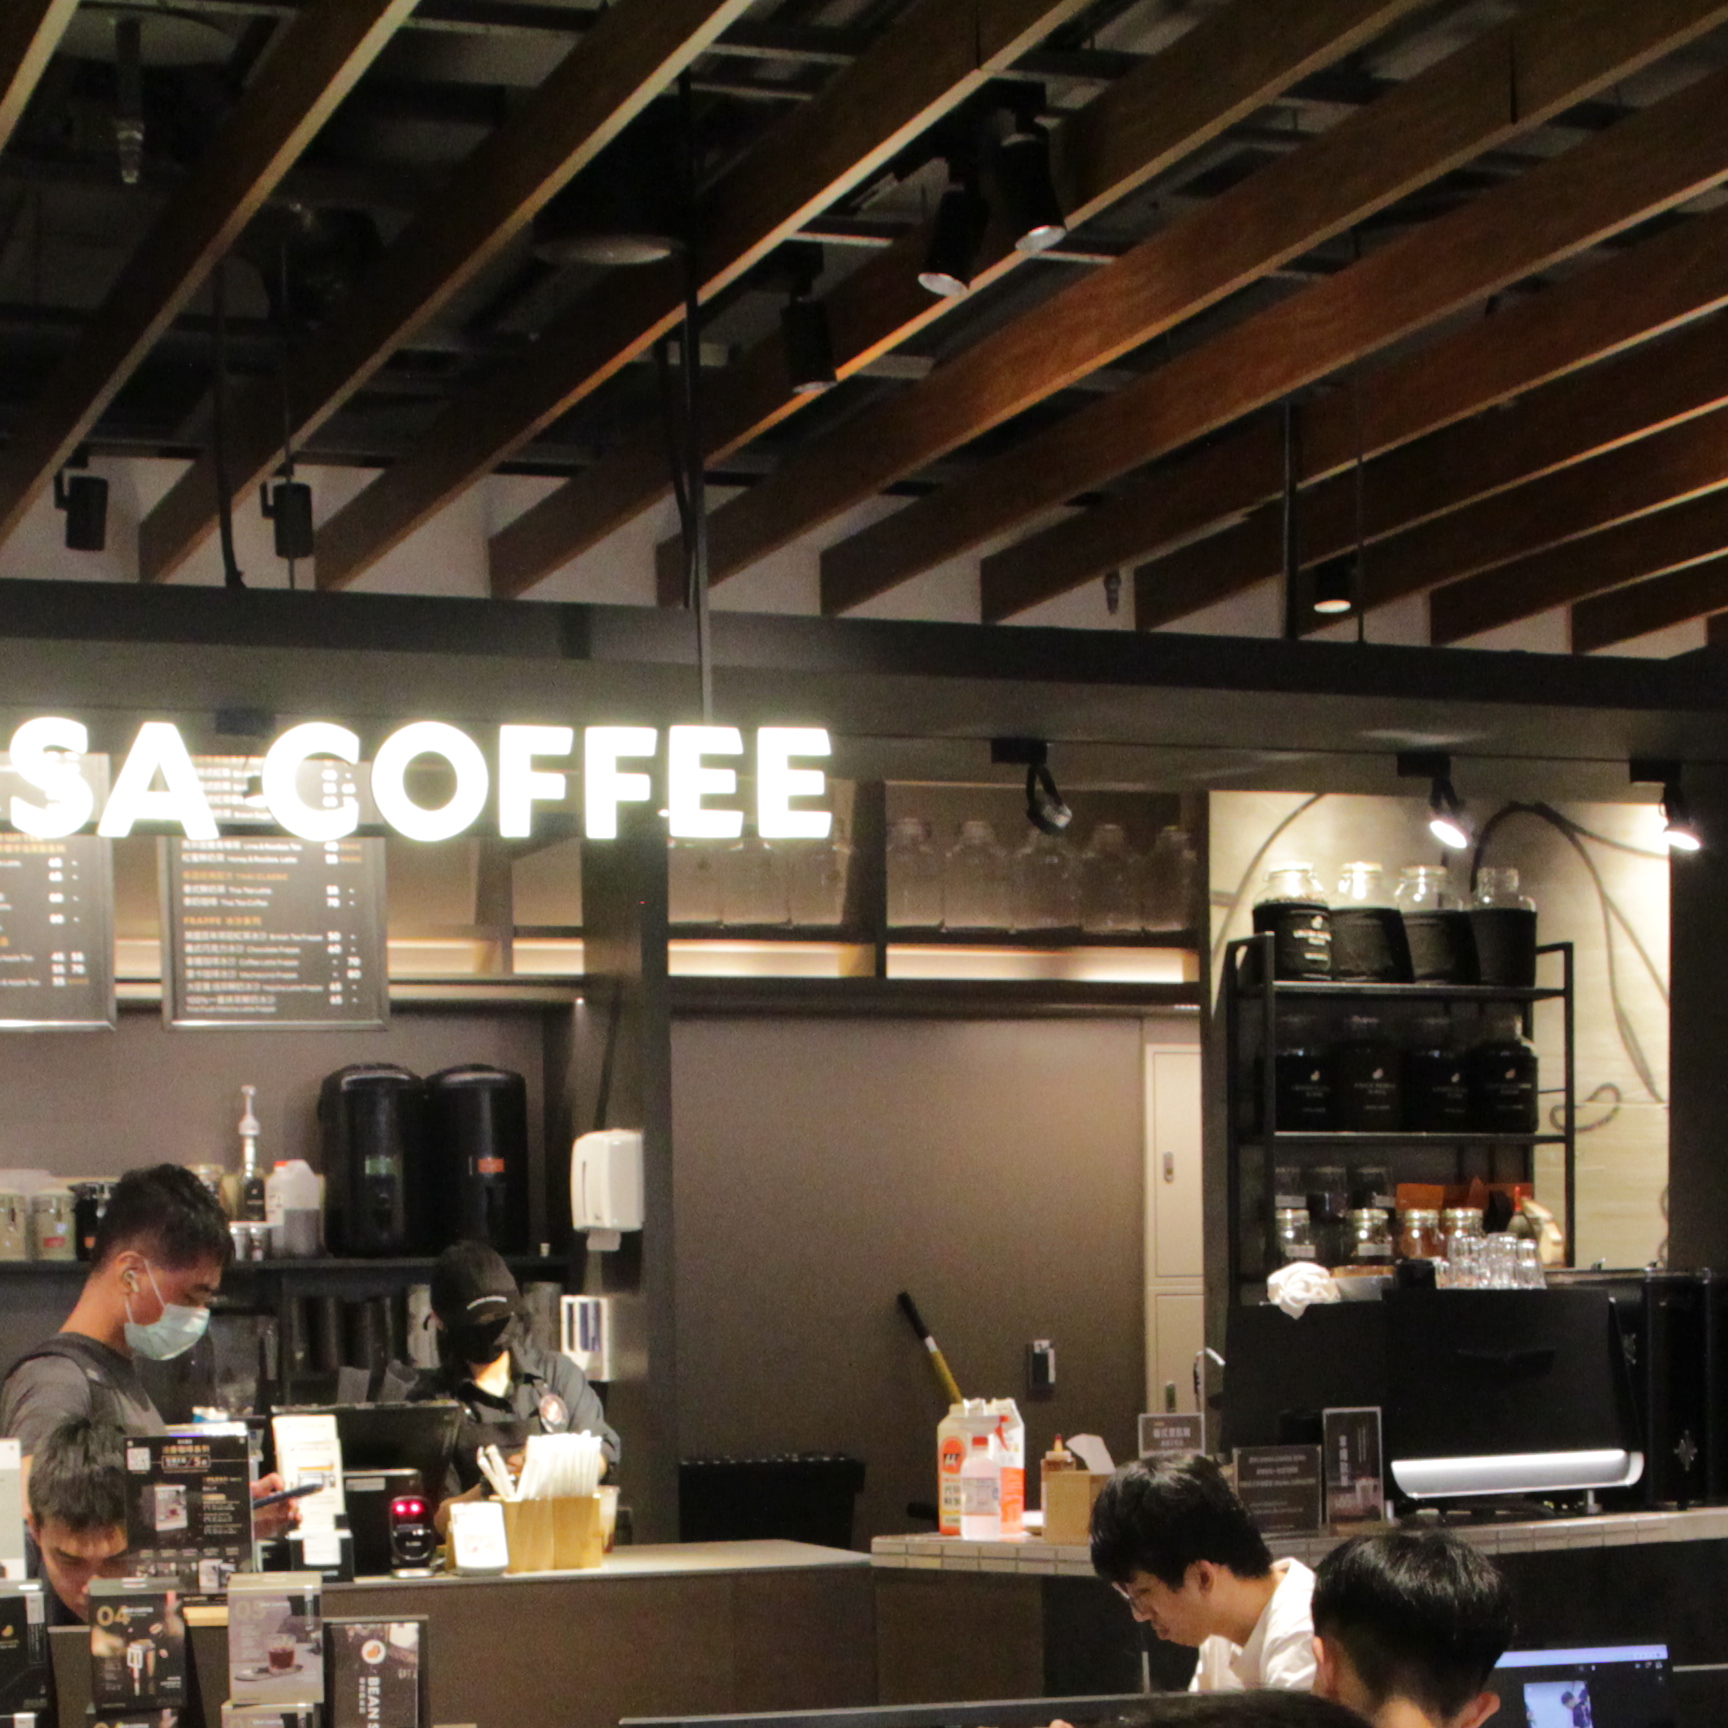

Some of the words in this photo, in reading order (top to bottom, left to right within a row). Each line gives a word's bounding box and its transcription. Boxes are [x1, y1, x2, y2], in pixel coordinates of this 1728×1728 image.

[262, 720, 834, 843] COFFEE
[327, 932, 342, 942] 50
[347, 957, 362, 966] 70
[97, 1605, 131, 1626] 04
[366, 1676, 381, 1720] BEAN
